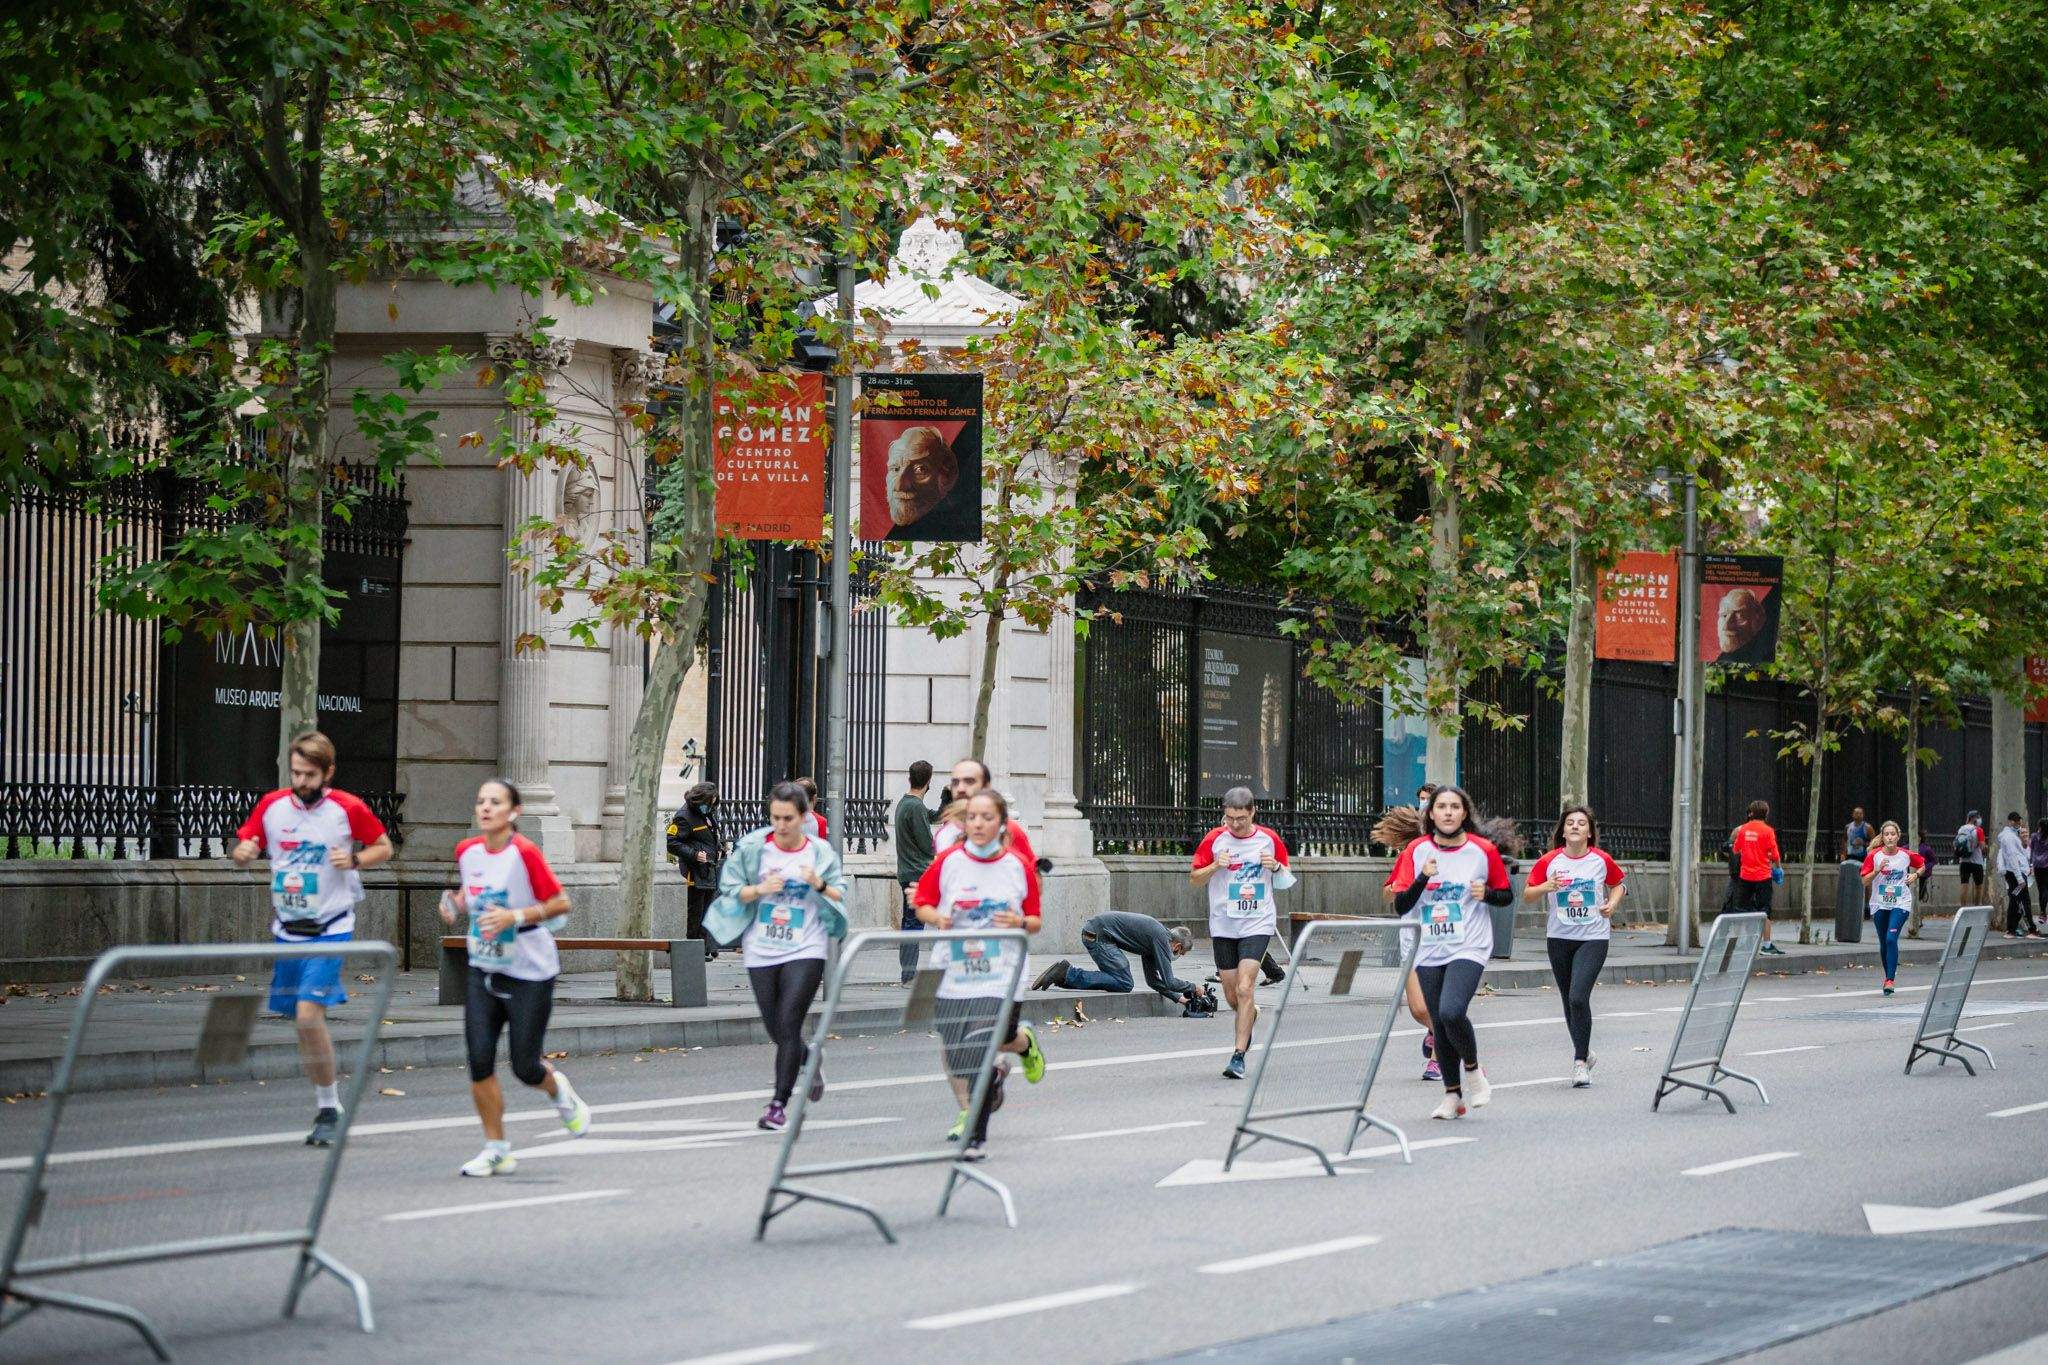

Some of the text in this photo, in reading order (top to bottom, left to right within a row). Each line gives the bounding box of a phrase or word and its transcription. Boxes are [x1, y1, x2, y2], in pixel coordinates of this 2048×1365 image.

[867, 377, 877, 385] 28
[914, 406, 947, 415] FERNÁN
[949, 406, 977, 416] GÓMEZ
[718, 423, 811, 442] GÓMEZ
[736, 448, 792, 457] CENTRO
[727, 460, 800, 470] CULTURAL
[717, 472, 809, 482] DE LA VILLA
[1617, 600, 1655, 608] CENTRO
[1611, 608, 1660, 616] CULTURAL
[216, 622, 281, 668] MAN
[215, 687, 247, 705] MUSEO
[318, 694, 363, 712] NACIONAL
[1237, 900, 1258, 911] 1074
[1566, 906, 1589, 918] 1042
[1429, 922, 1455, 936] 1044
